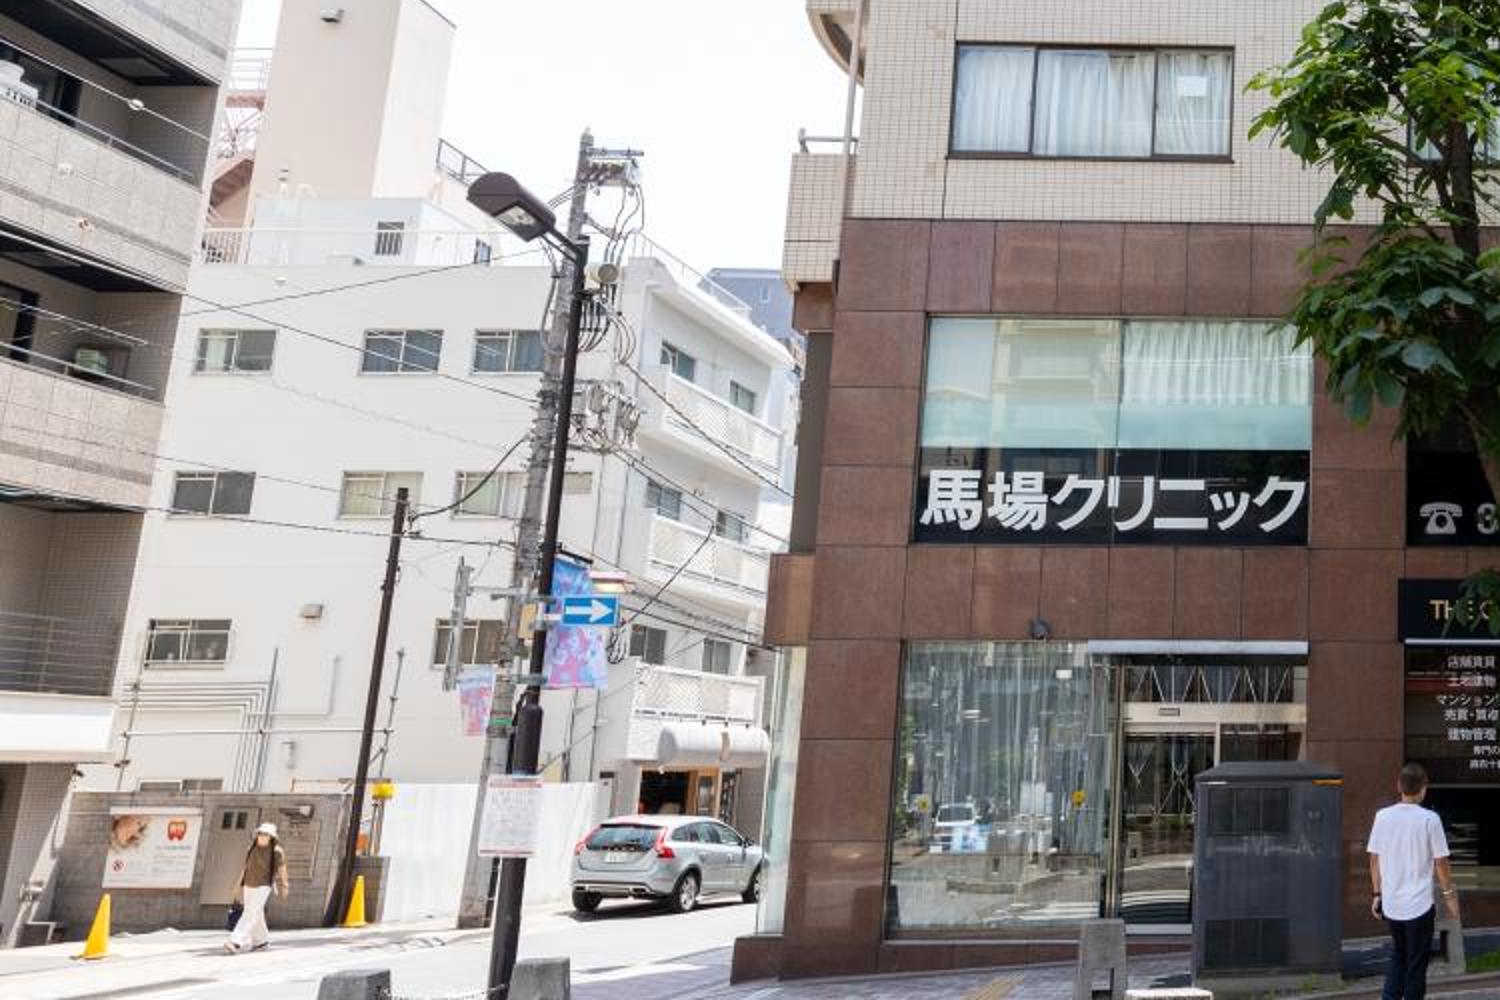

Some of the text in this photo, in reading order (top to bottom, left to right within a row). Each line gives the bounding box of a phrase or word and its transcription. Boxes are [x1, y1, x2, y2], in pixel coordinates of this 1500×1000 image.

[919, 469, 1307, 533] 馬場クリニック
